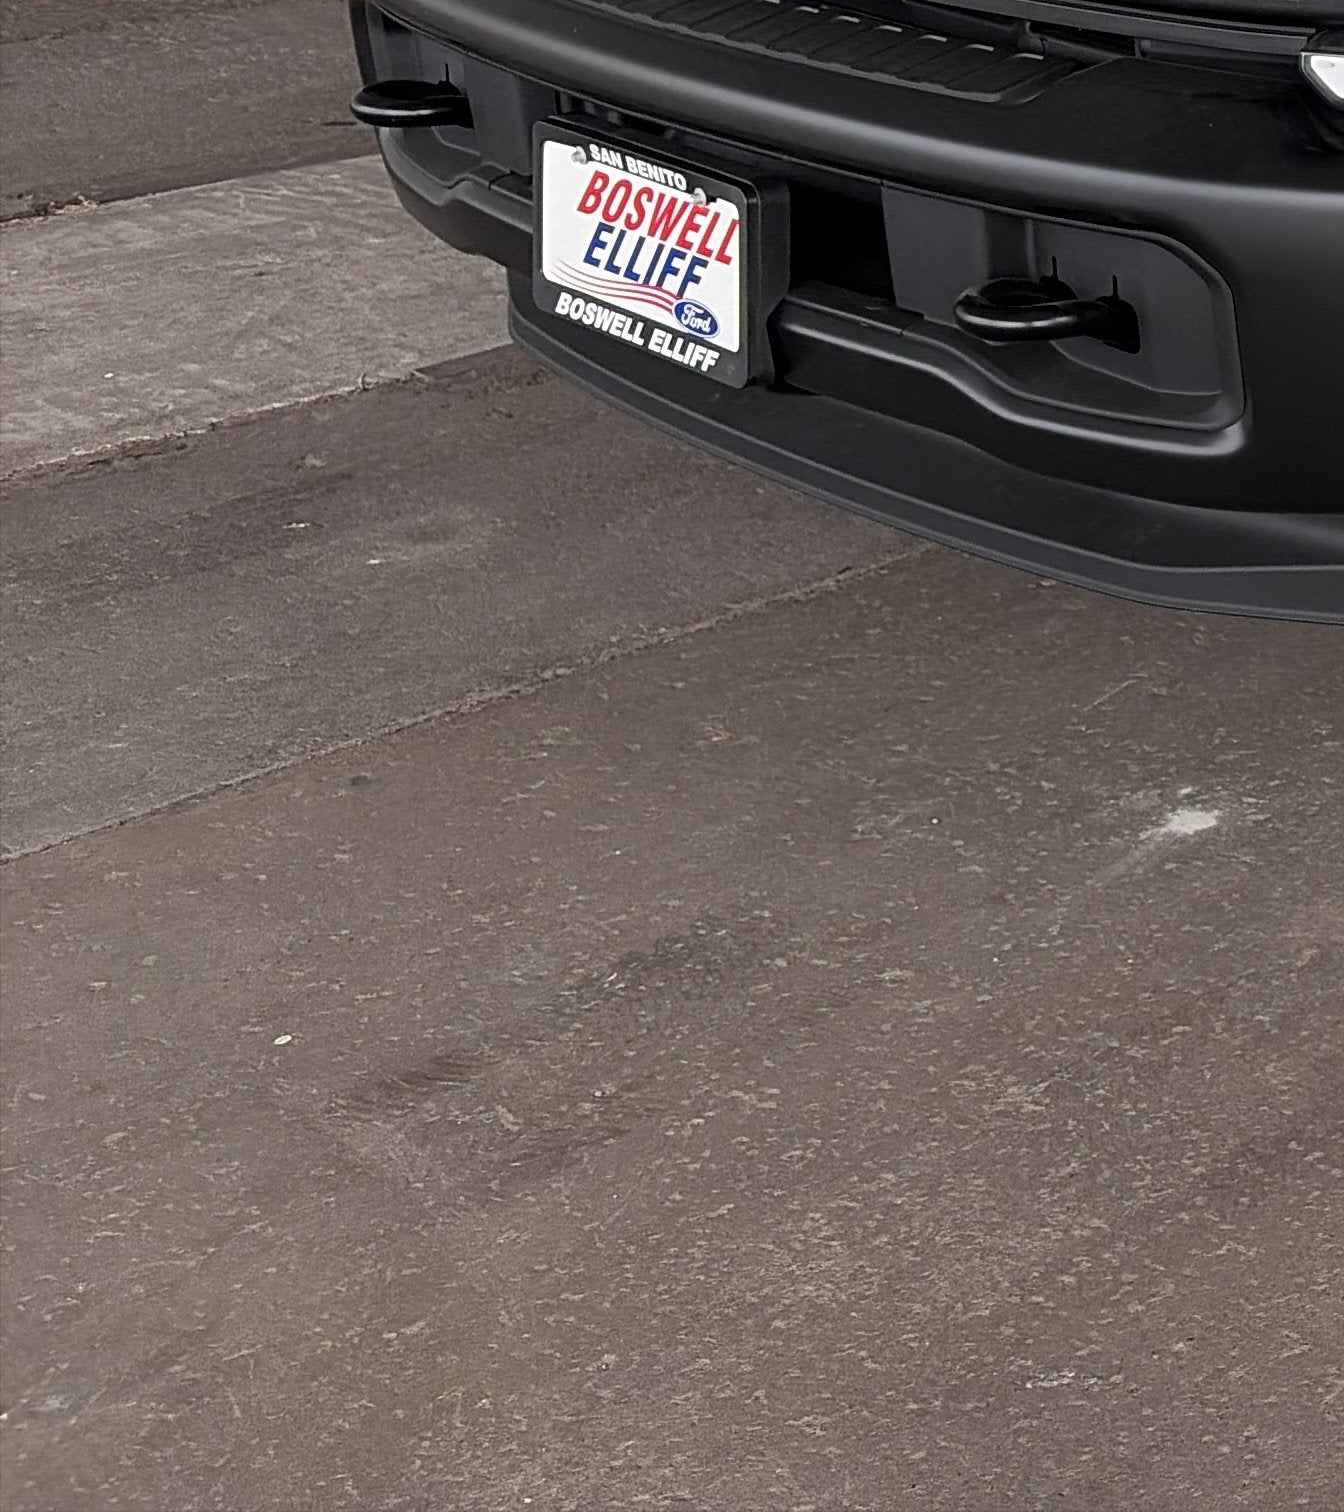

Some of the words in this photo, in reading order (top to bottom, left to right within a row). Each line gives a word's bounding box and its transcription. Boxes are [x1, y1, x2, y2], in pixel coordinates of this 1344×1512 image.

[588, 143, 624, 170] SAN
[624, 155, 688, 192] BENITO
[576, 170, 743, 266] BOSWELL
[582, 221, 709, 299] ELLIFF
[554, 291, 646, 347] BOSWELL
[647, 329, 721, 374] ELLIFF
[680, 302, 714, 334] Ford
